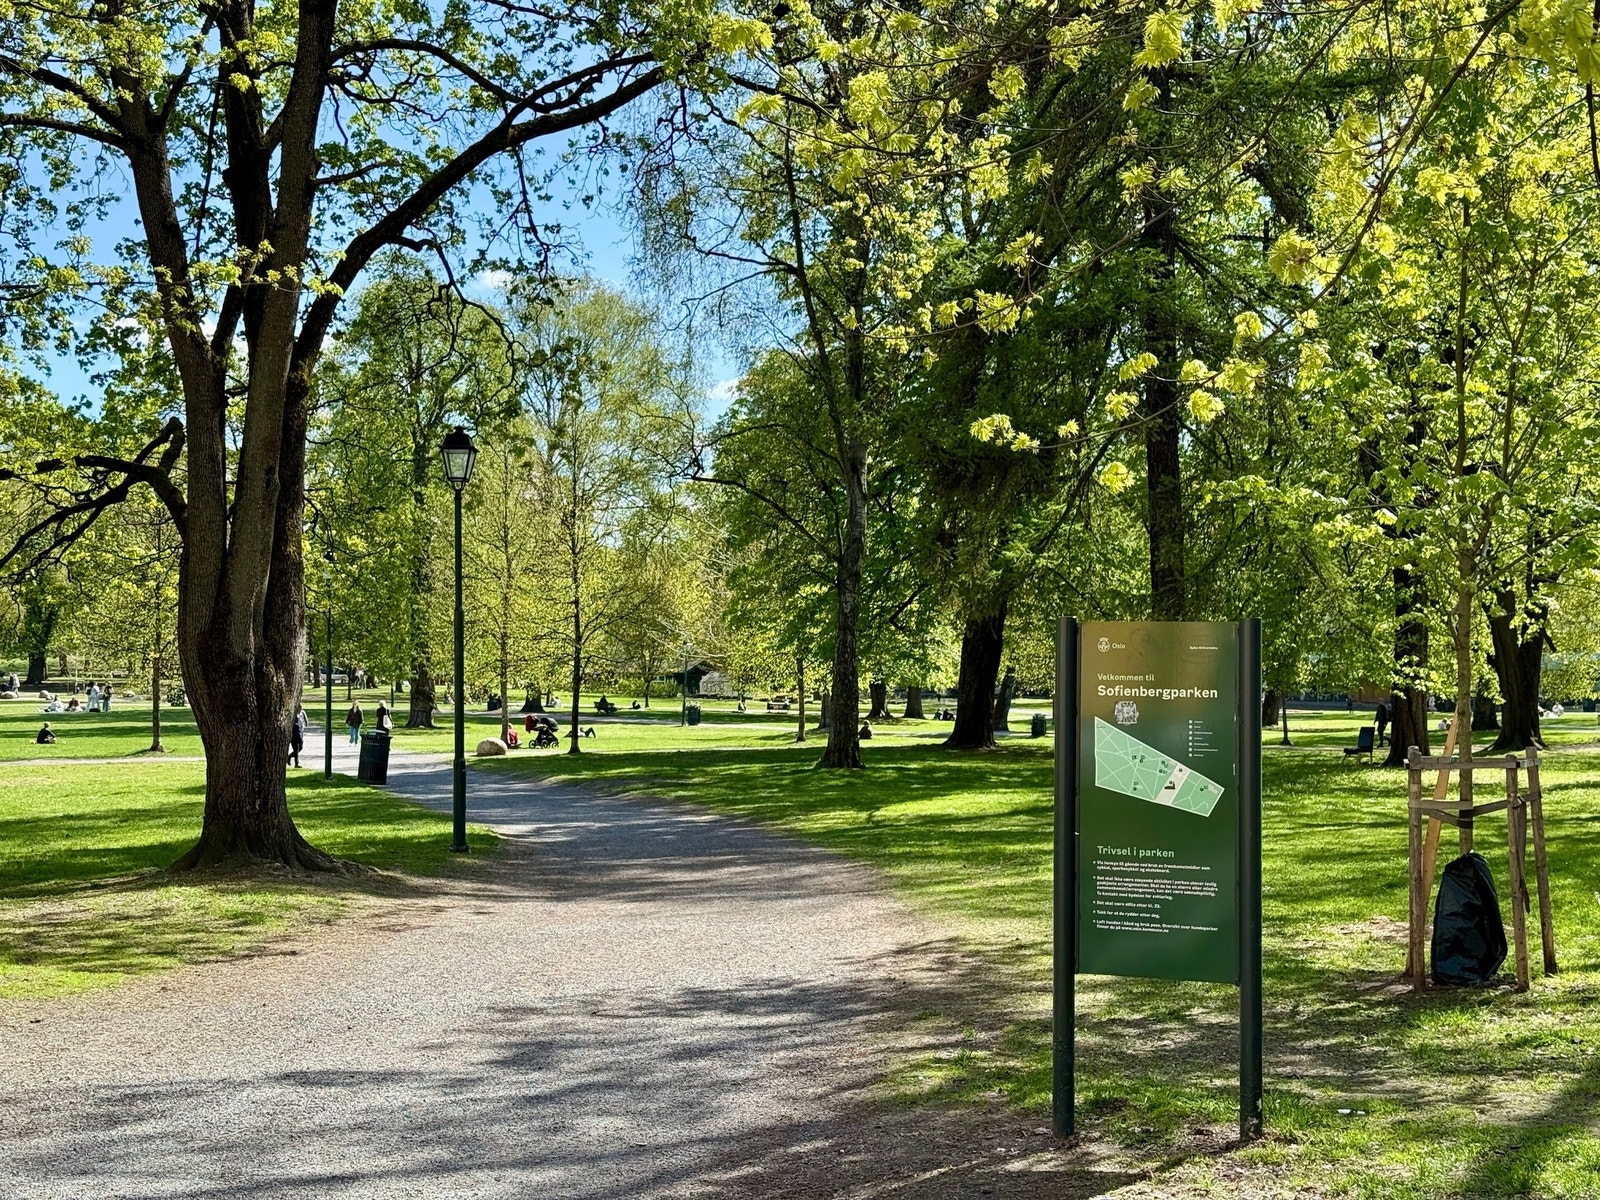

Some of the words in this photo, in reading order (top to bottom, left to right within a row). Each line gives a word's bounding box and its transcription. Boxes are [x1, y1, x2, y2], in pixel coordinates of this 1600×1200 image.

[1097, 673, 1144, 681] Velkommen
[1097, 685, 1218, 700] Sofienbergparken
[1096, 846, 1131, 856] Trivsel
[1133, 847, 1137, 856] i
[1139, 849, 1175, 858] parken
